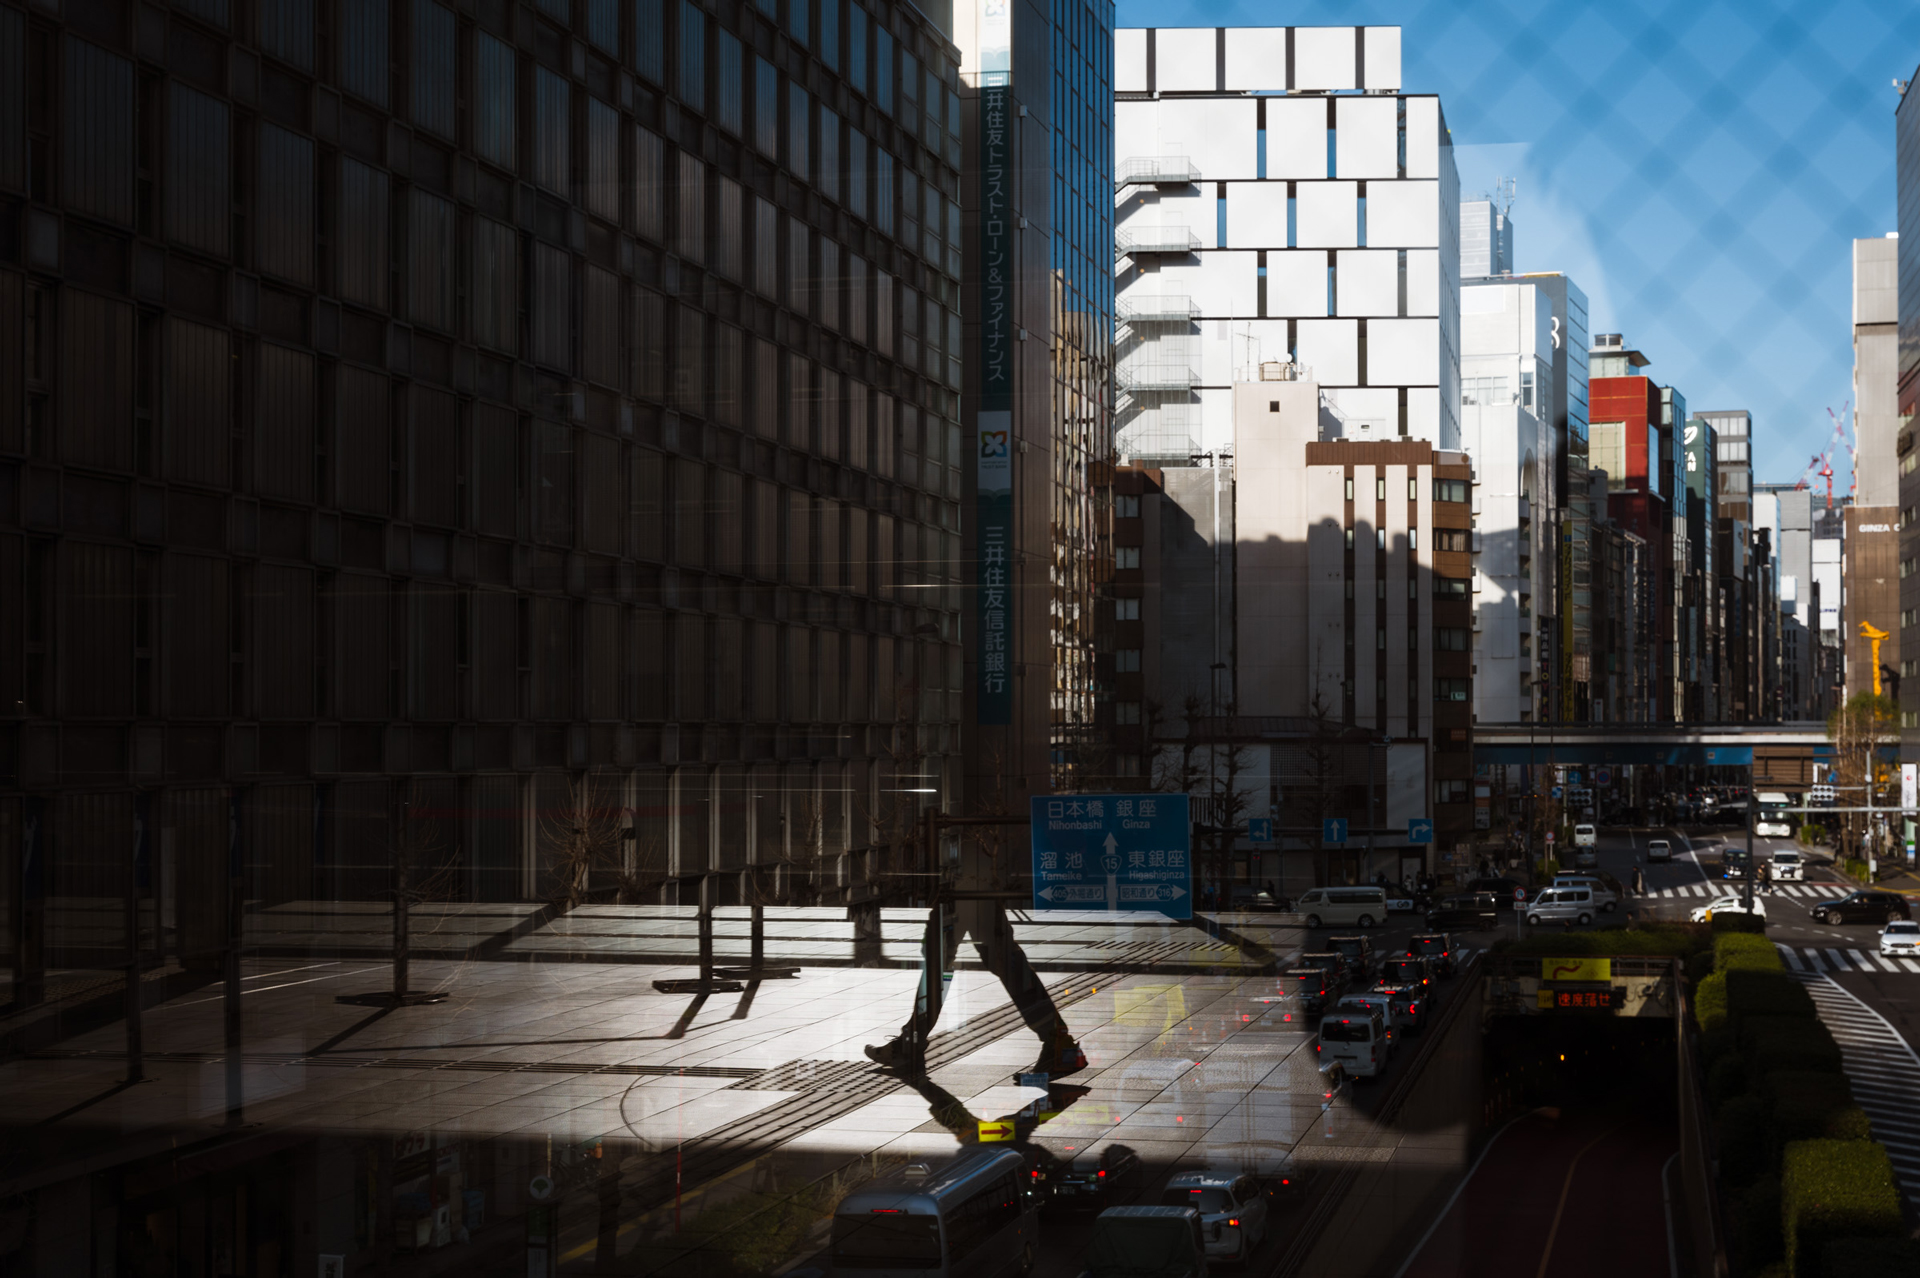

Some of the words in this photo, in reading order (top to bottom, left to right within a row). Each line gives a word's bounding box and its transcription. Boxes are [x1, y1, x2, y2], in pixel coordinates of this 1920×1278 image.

[1859, 524, 1890, 532] GINZA
[984, 526, 1005, 693] 三井住友信託銀行
[1048, 801, 1104, 818] 日本橋
[1116, 800, 1156, 817] 銀座
[1049, 820, 1102, 830] Nihonbashi
[1122, 819, 1150, 829] Ginza
[1040, 852, 1083, 869] 溜池
[1105, 858, 1117, 869] 15
[1128, 850, 1185, 868] 東銀座
[1041, 871, 1082, 880] Tameike
[1129, 870, 1184, 881] Higashiginza
[1054, 889, 1067, 898] 405
[1069, 888, 1103, 899] 外堀通り
[1121, 888, 1154, 898] 昭和通り
[1158, 888, 1170, 896] 316
[1558, 992, 1611, 1007] 速度落せ
